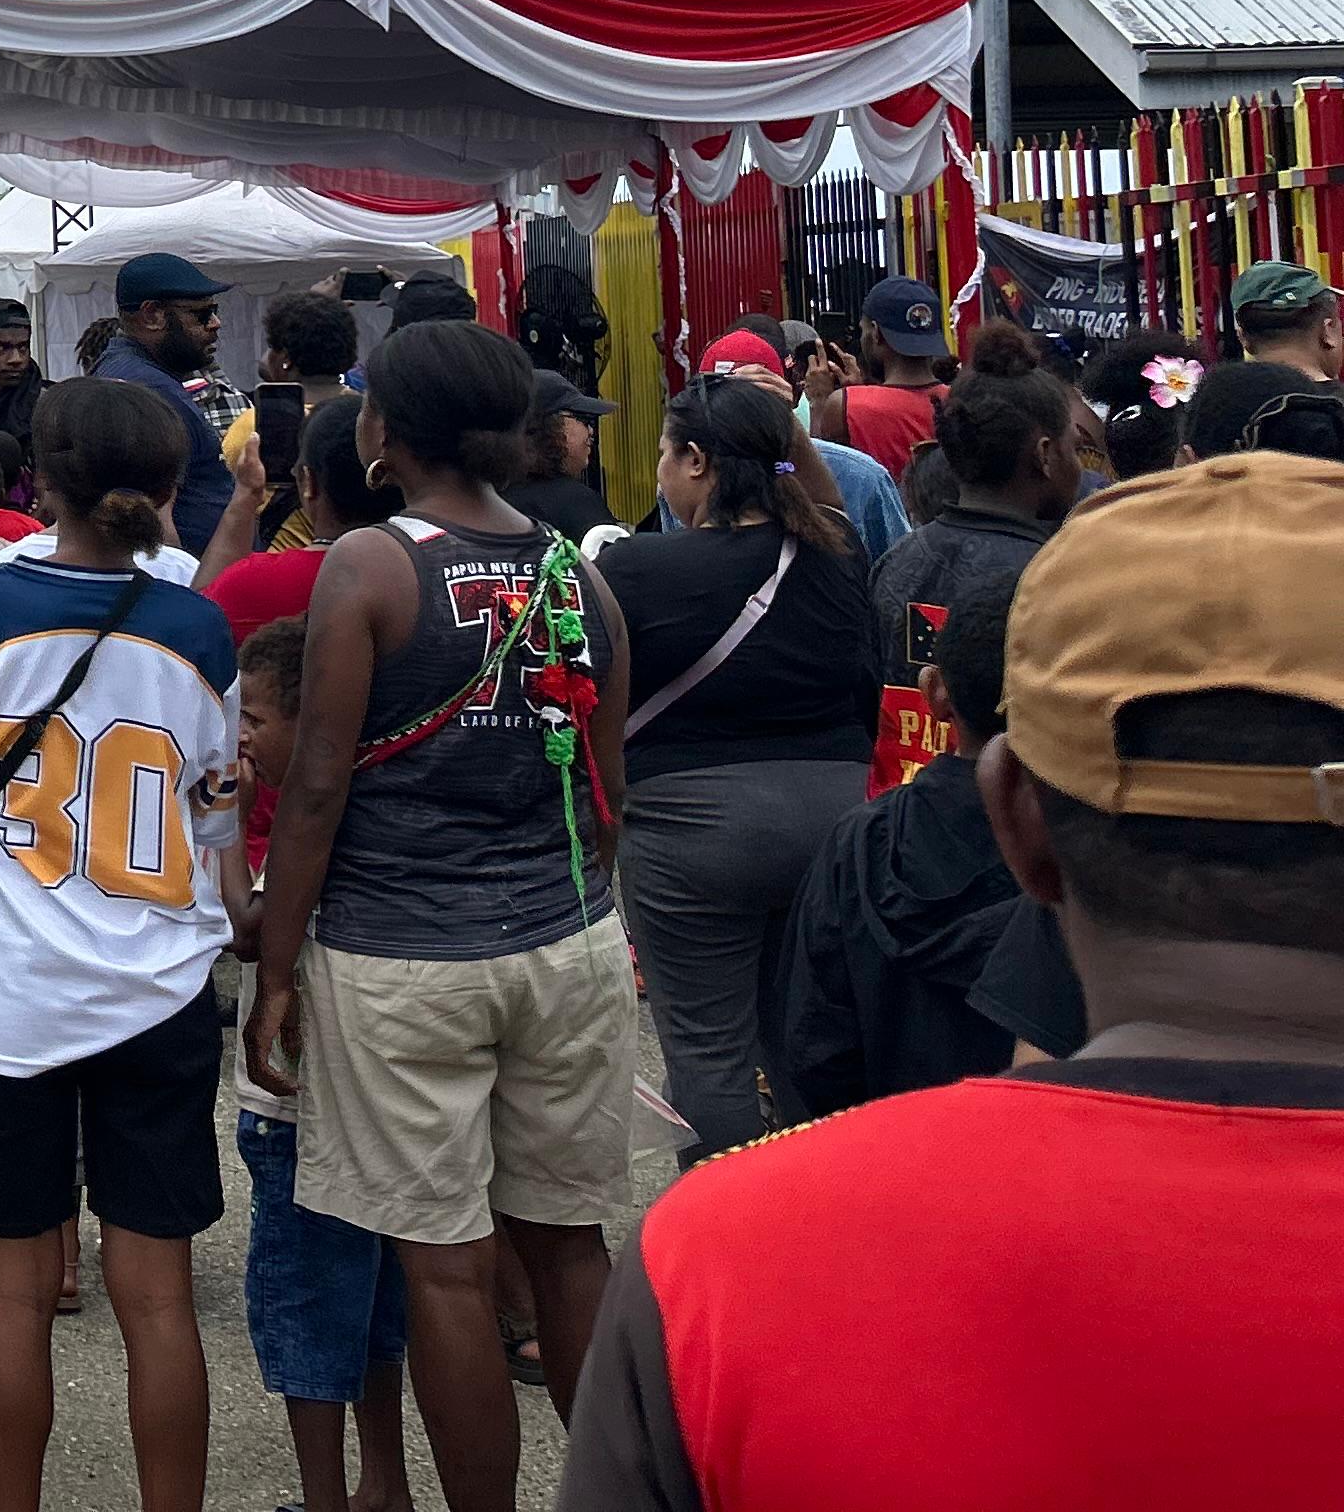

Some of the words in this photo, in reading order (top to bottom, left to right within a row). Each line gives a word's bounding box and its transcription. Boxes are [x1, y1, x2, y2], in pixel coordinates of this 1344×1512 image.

[1045, 276, 1085, 301] PNG
[444, 562, 486, 579] PAPUA
[460, 714, 498, 727] LAND
[505, 715, 522, 728] OF
